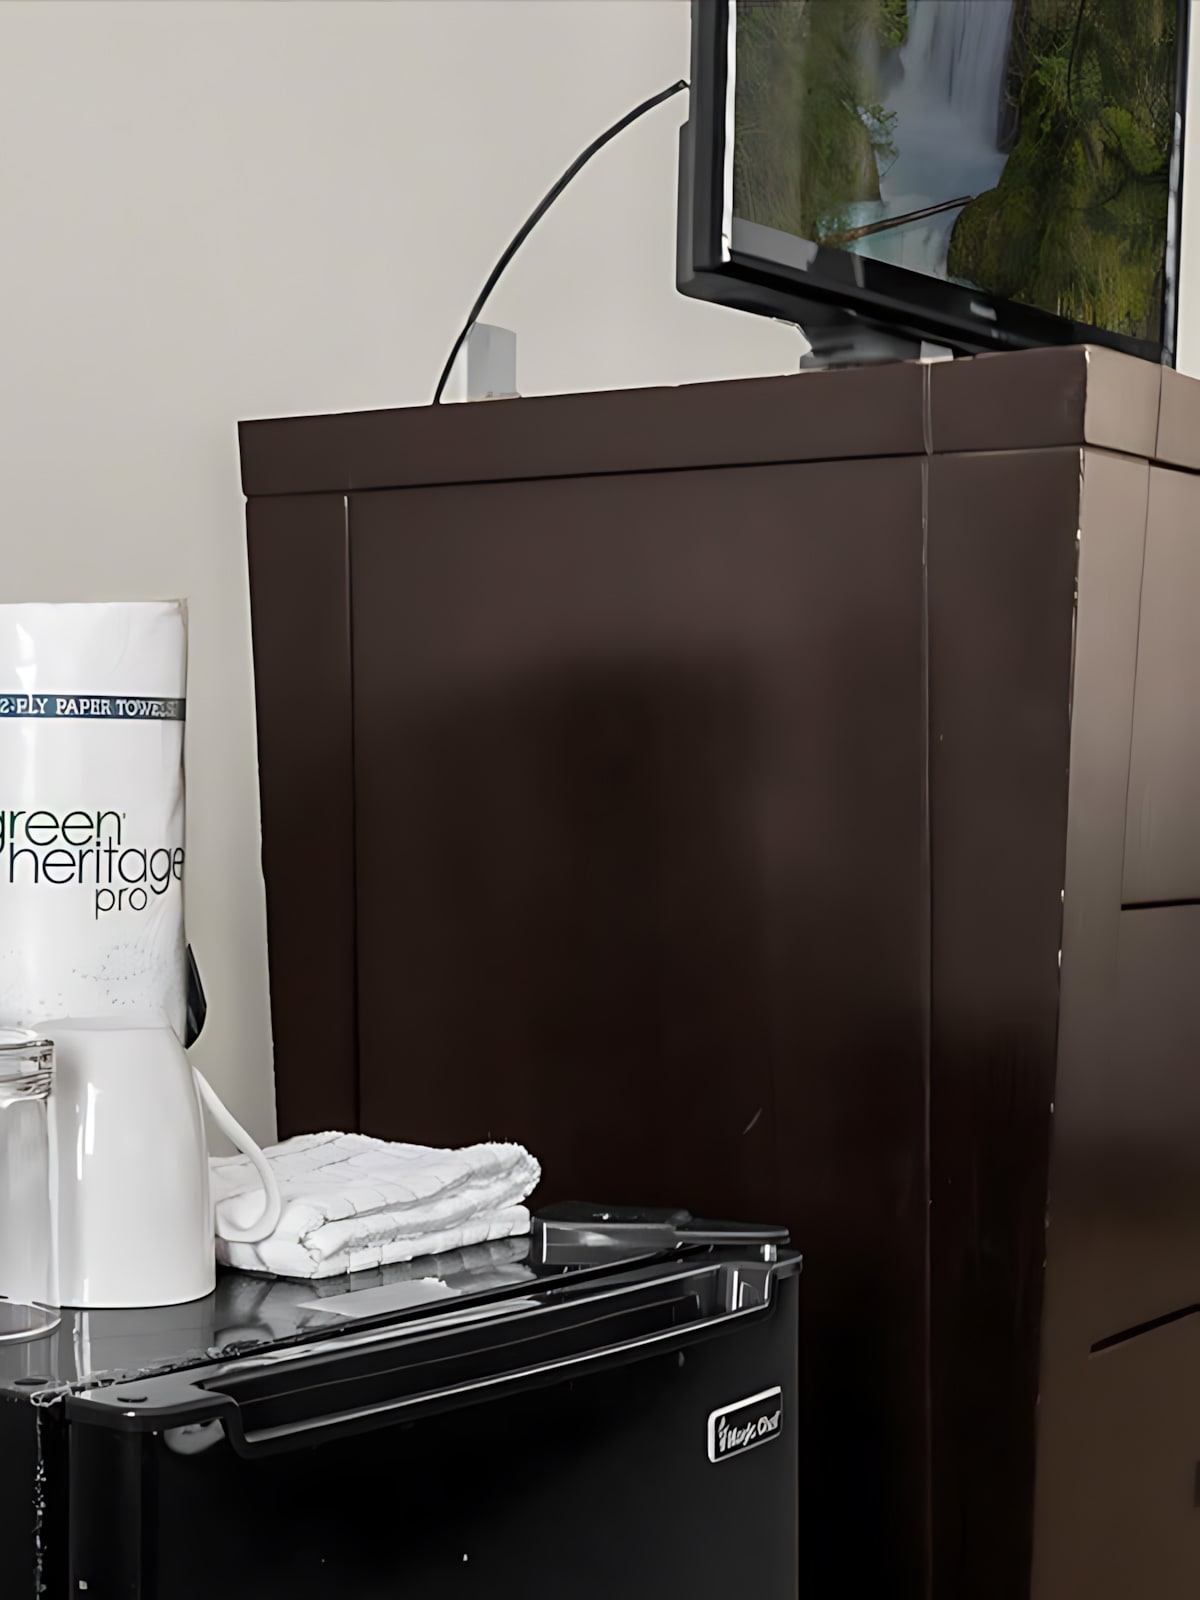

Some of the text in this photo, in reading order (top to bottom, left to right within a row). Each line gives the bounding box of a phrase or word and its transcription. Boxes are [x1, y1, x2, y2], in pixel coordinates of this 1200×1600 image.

[55, 698, 112, 716] PAPER
[9, 836, 185, 895] heritage
[95, 887, 148, 920] pro
